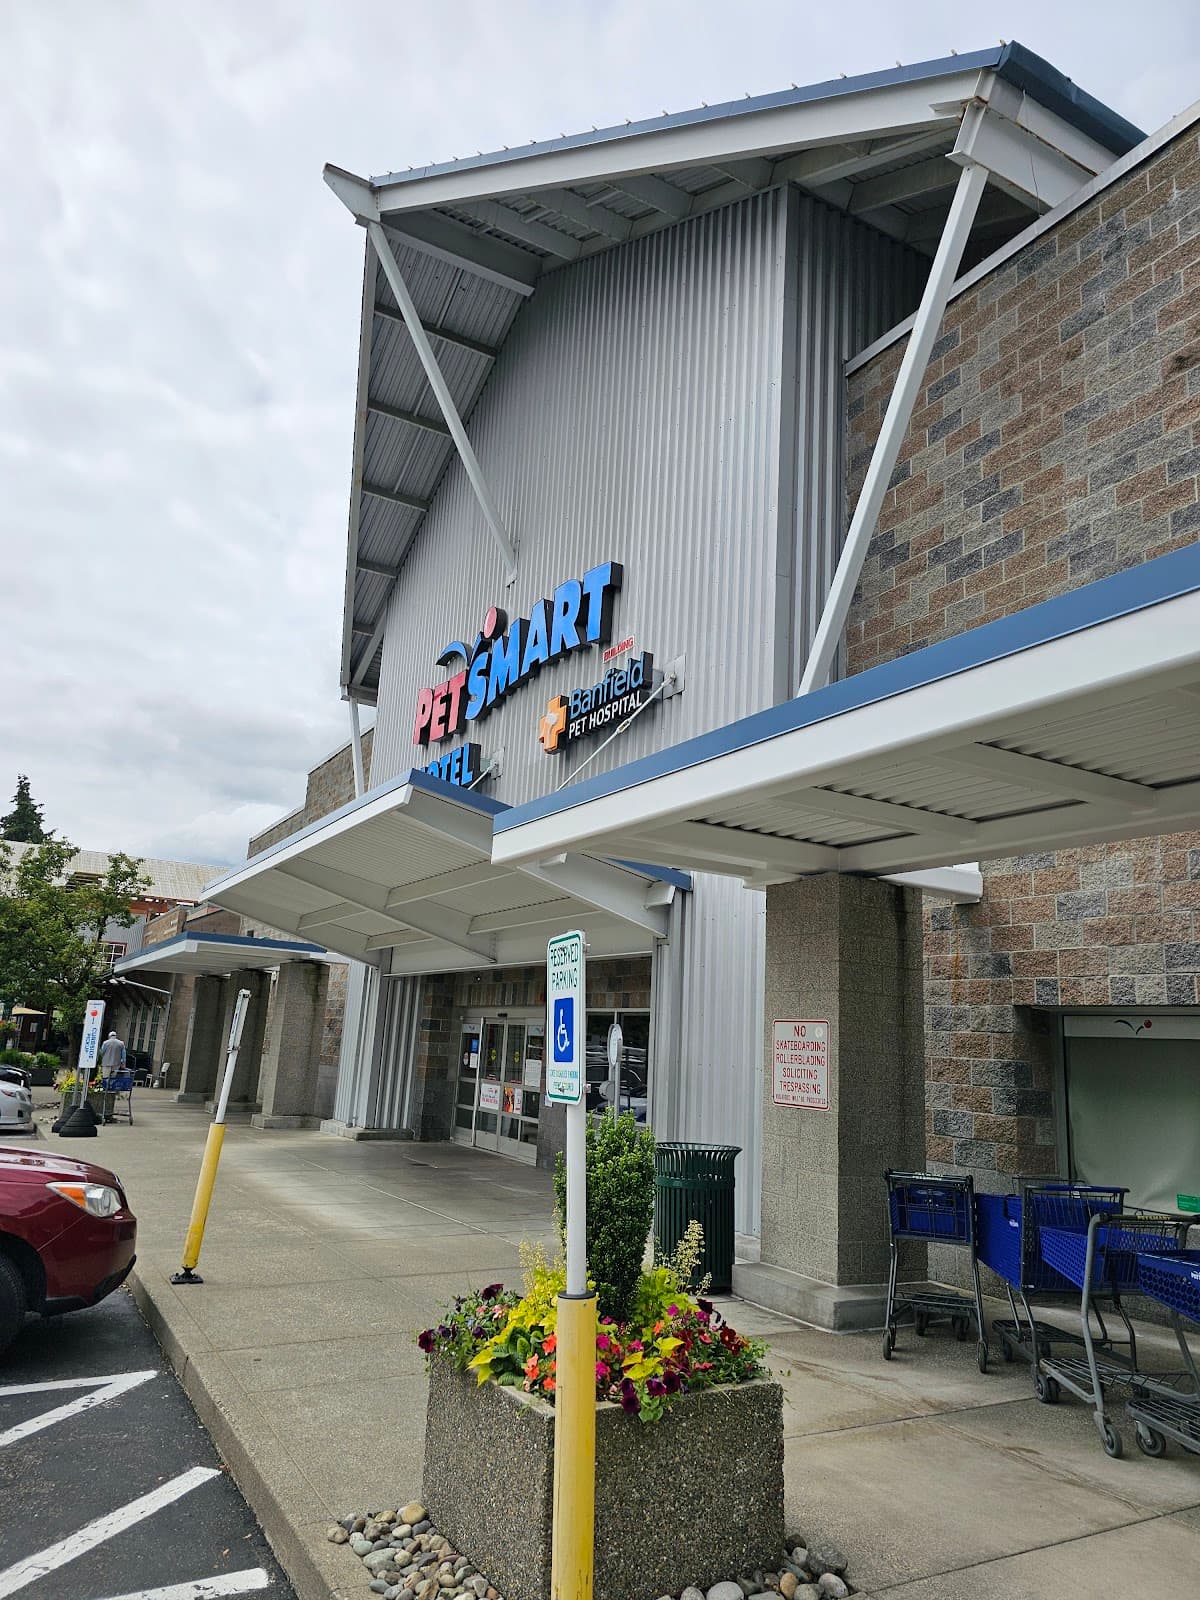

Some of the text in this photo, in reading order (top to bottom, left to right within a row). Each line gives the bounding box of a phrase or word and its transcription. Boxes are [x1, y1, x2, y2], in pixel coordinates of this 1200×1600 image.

[570, 651, 644, 719] Banfield
[569, 690, 642, 739] PET HOSPITAL
[550, 943, 578, 967] RESERVED
[552, 967, 577, 991] PARKING
[794, 1025, 806, 1037] NO
[776, 1040, 826, 1052] SKATEBOARDING
[776, 1053, 825, 1066] ROLLERBLADING
[783, 1067, 818, 1079] SOLICITING
[780, 1081, 821, 1095] TRESPASSING
